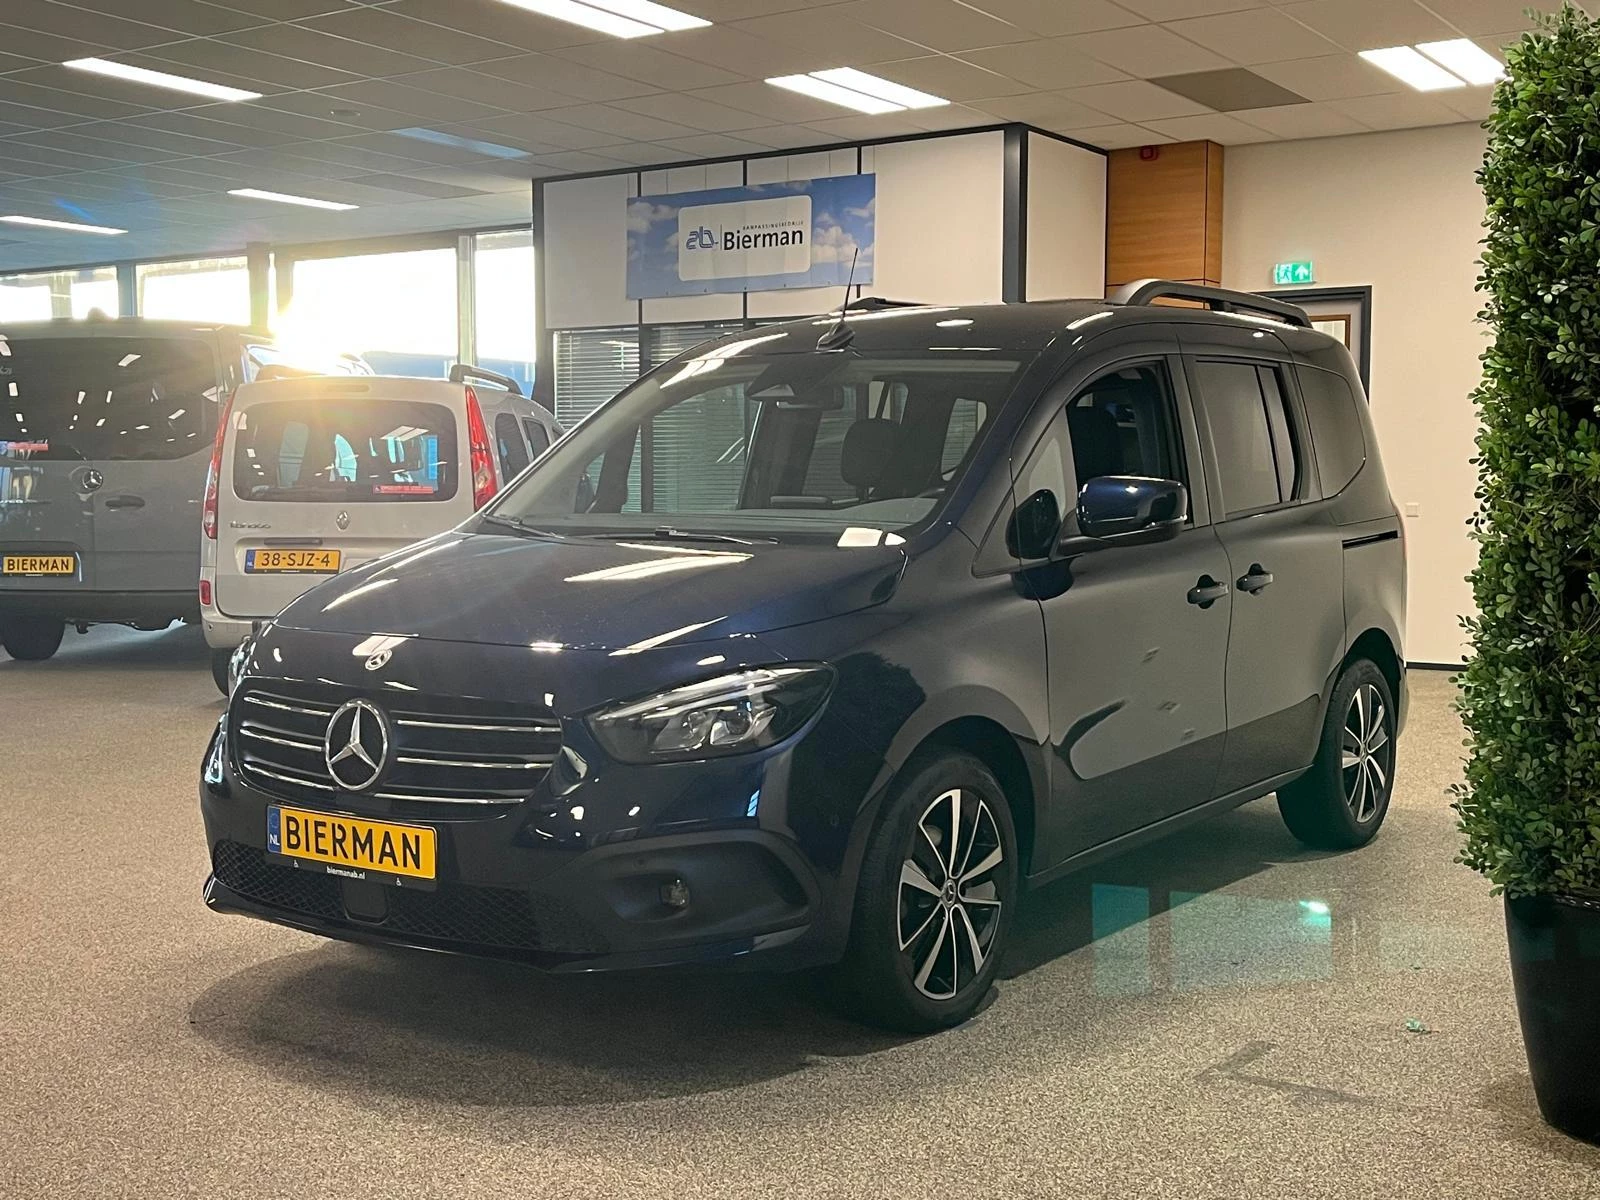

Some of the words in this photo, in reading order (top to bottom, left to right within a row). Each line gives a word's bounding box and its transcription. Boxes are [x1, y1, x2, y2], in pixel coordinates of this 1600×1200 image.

[723, 229, 803, 250] Bierman
[7, 559, 70, 571] BIERMAN
[261, 552, 331, 567] 38-SJZ-4
[269, 834, 280, 846] NL
[286, 815, 420, 870] BIERMAN
[326, 866, 366, 880] biermanab.nl
